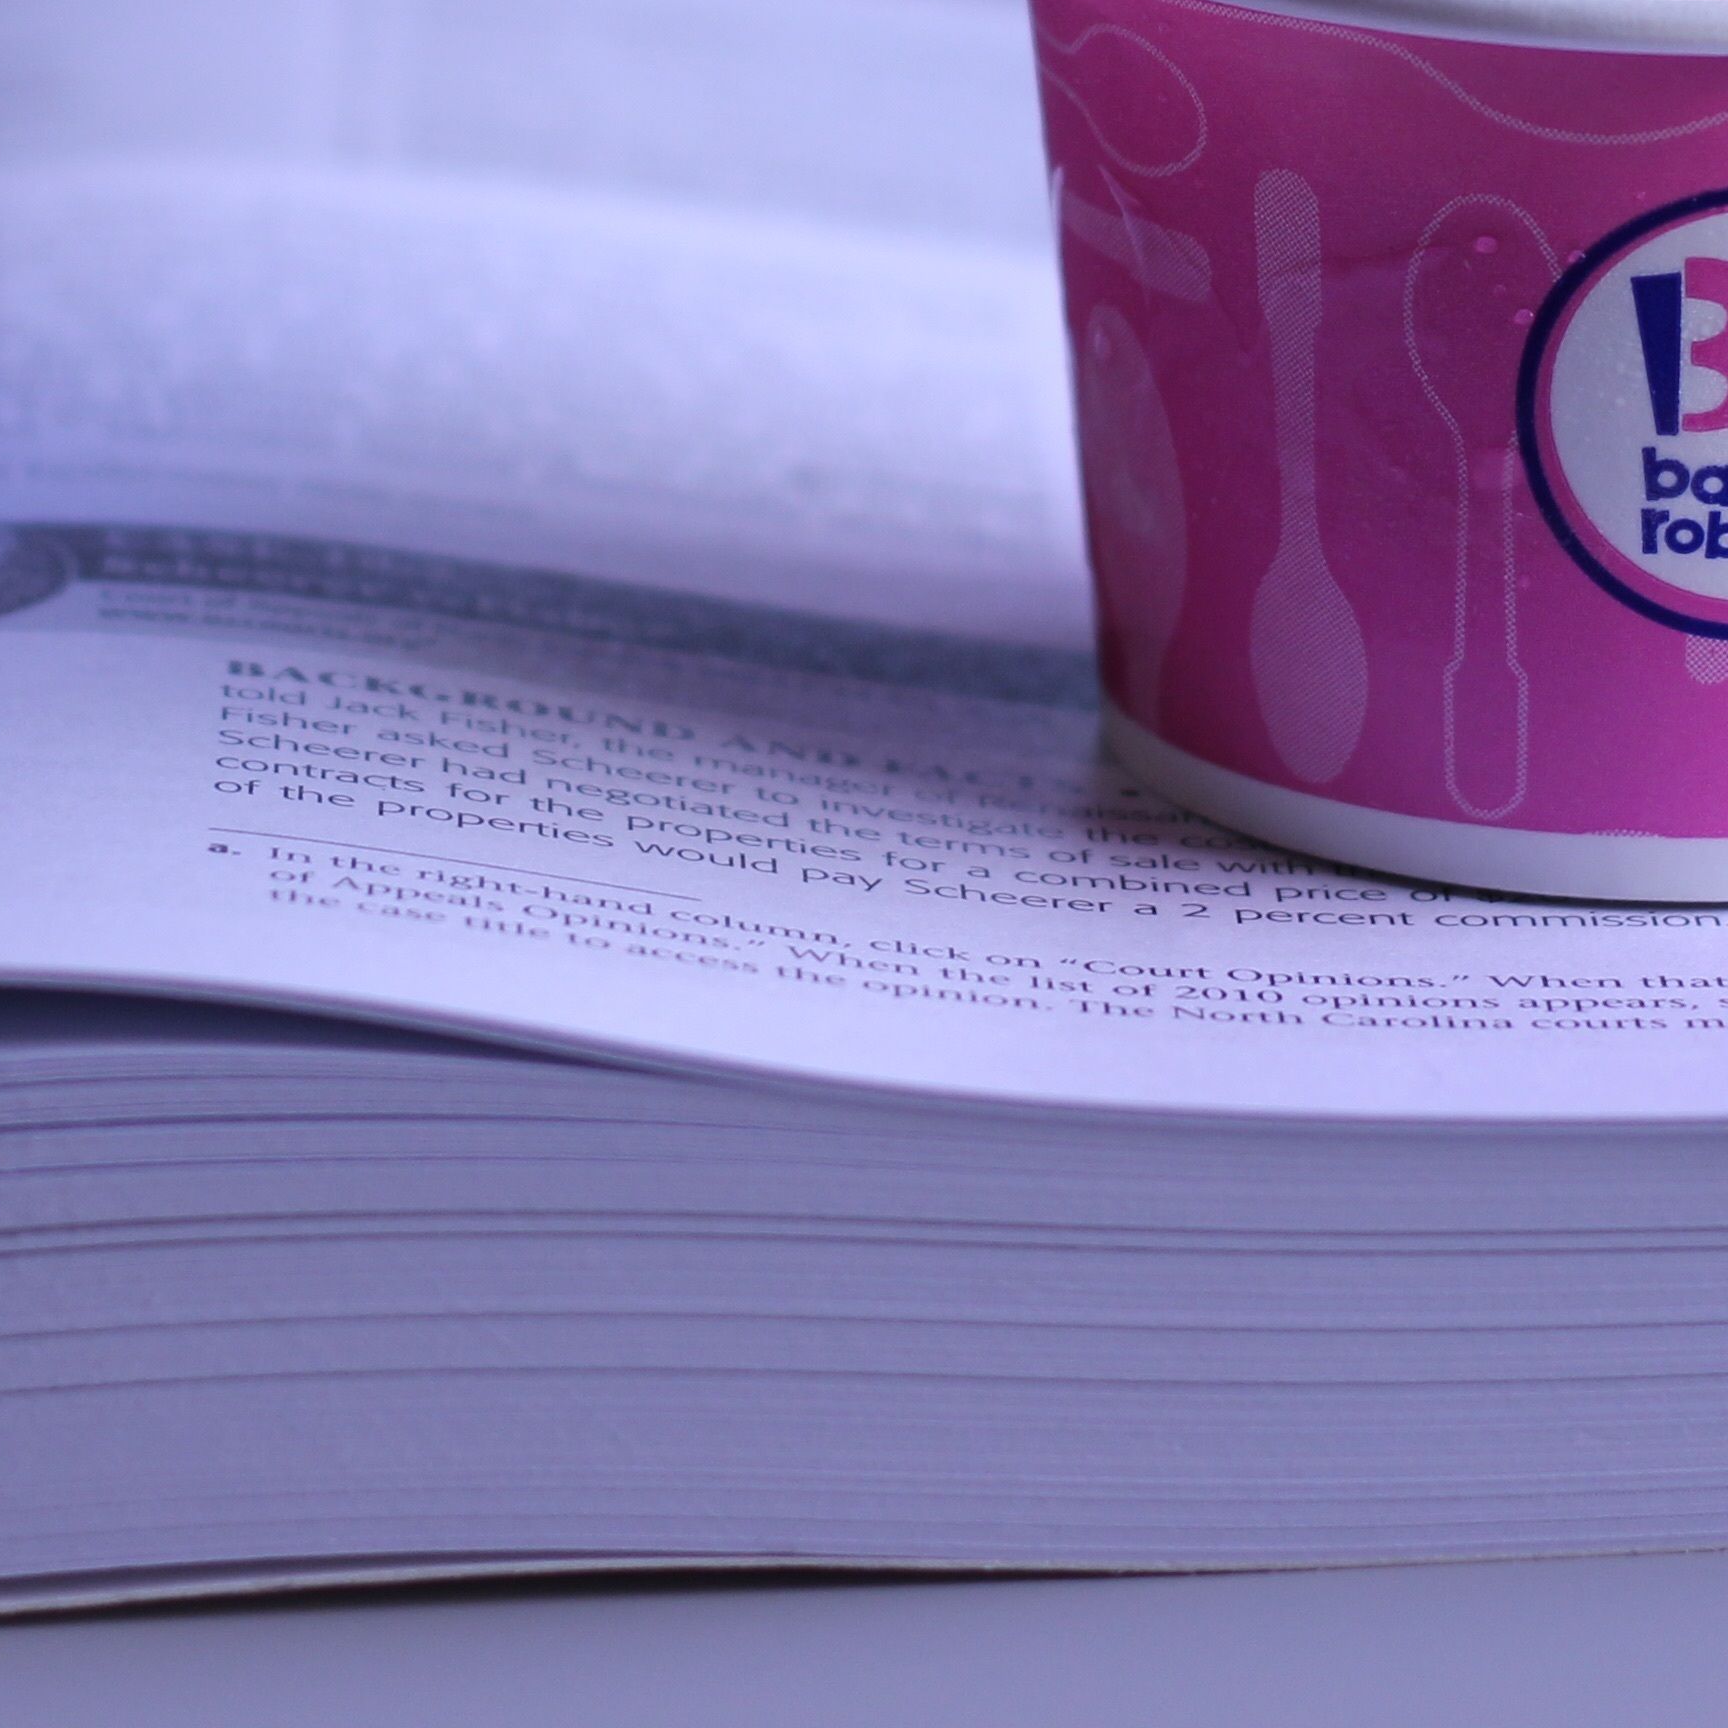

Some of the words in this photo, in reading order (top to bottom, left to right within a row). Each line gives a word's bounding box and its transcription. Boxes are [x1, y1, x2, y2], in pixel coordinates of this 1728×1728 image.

[217, 728, 425, 769] Scheerer
[442, 755, 527, 786] had
[546, 776, 790, 828] negotiated
[808, 817, 881, 842] the
[897, 830, 1031, 860] terms
[1048, 847, 1092, 865] of
[1110, 853, 1201, 872] sale
[220, 705, 358, 736] Fisher
[376, 727, 510, 759] asked
[531, 746, 737, 795] Scheerer
[753, 785, 800, 806] to
[821, 797, 1065, 842] investigate
[1086, 825, 1160, 847] the
[221, 683, 307, 707] told
[332, 694, 421, 721] Jack
[438, 709, 581, 750] Fisher,
[600, 736, 675, 762] the
[692, 754, 896, 797] manager
[213, 778, 261, 796] of
[279, 784, 356, 808] the
[377, 799, 615, 848] properties
[633, 839, 779, 875] would
[800, 866, 883, 892] pay
[904, 877, 1113, 912] Scheerer
[1133, 903, 1158, 917] a
[1180, 902, 1211, 918] 2
[1234, 907, 1416, 925] percent
[215, 755, 426, 793] contracts
[445, 781, 511, 806] for
[528, 796, 605, 822] the
[626, 813, 862, 863] properties
[882, 850, 947, 873] for
[966, 865, 992, 879] a
[1013, 869, 1252, 898] combined
[1274, 883, 1389, 903] price
[207, 842, 241, 856] a.
[270, 846, 312, 864] In
[329, 854, 401, 875] the
[419, 869, 653, 916] right-hand
[670, 910, 851, 949] column,
[869, 939, 971, 963] click
[985, 953, 1042, 969] on
[1059, 957, 1211, 979] “Court
[1226, 966, 1470, 989] Opinions.”
[1486, 973, 1625, 989] When
[1640, 974, 1728, 989] that
[269, 870, 314, 884] of
[332, 875, 505, 913] Appeals
[521, 903, 766, 952] Opinions.”
[787, 944, 920, 977] When
[939, 966, 1011, 986] the
[1029, 975, 1093, 994] list
[1112, 983, 1156, 998] of
[1174, 984, 1284, 1004] 2010
[1301, 992, 1500, 1011] opinions
[1517, 995, 1699, 1013] appears,
[269, 887, 341, 907] the
[356, 901, 447, 923] case
[463, 915, 551, 940] title
[567, 931, 611, 950] to
[625, 941, 760, 974] access
[775, 965, 847, 986] the
[861, 977, 1054, 1011] opinion.
[1068, 997, 1156, 1019] The
[1171, 1004, 1304, 1026] North
[1321, 1011, 1514, 1030] Carolina
[1530, 1015, 1669, 1030] courts
